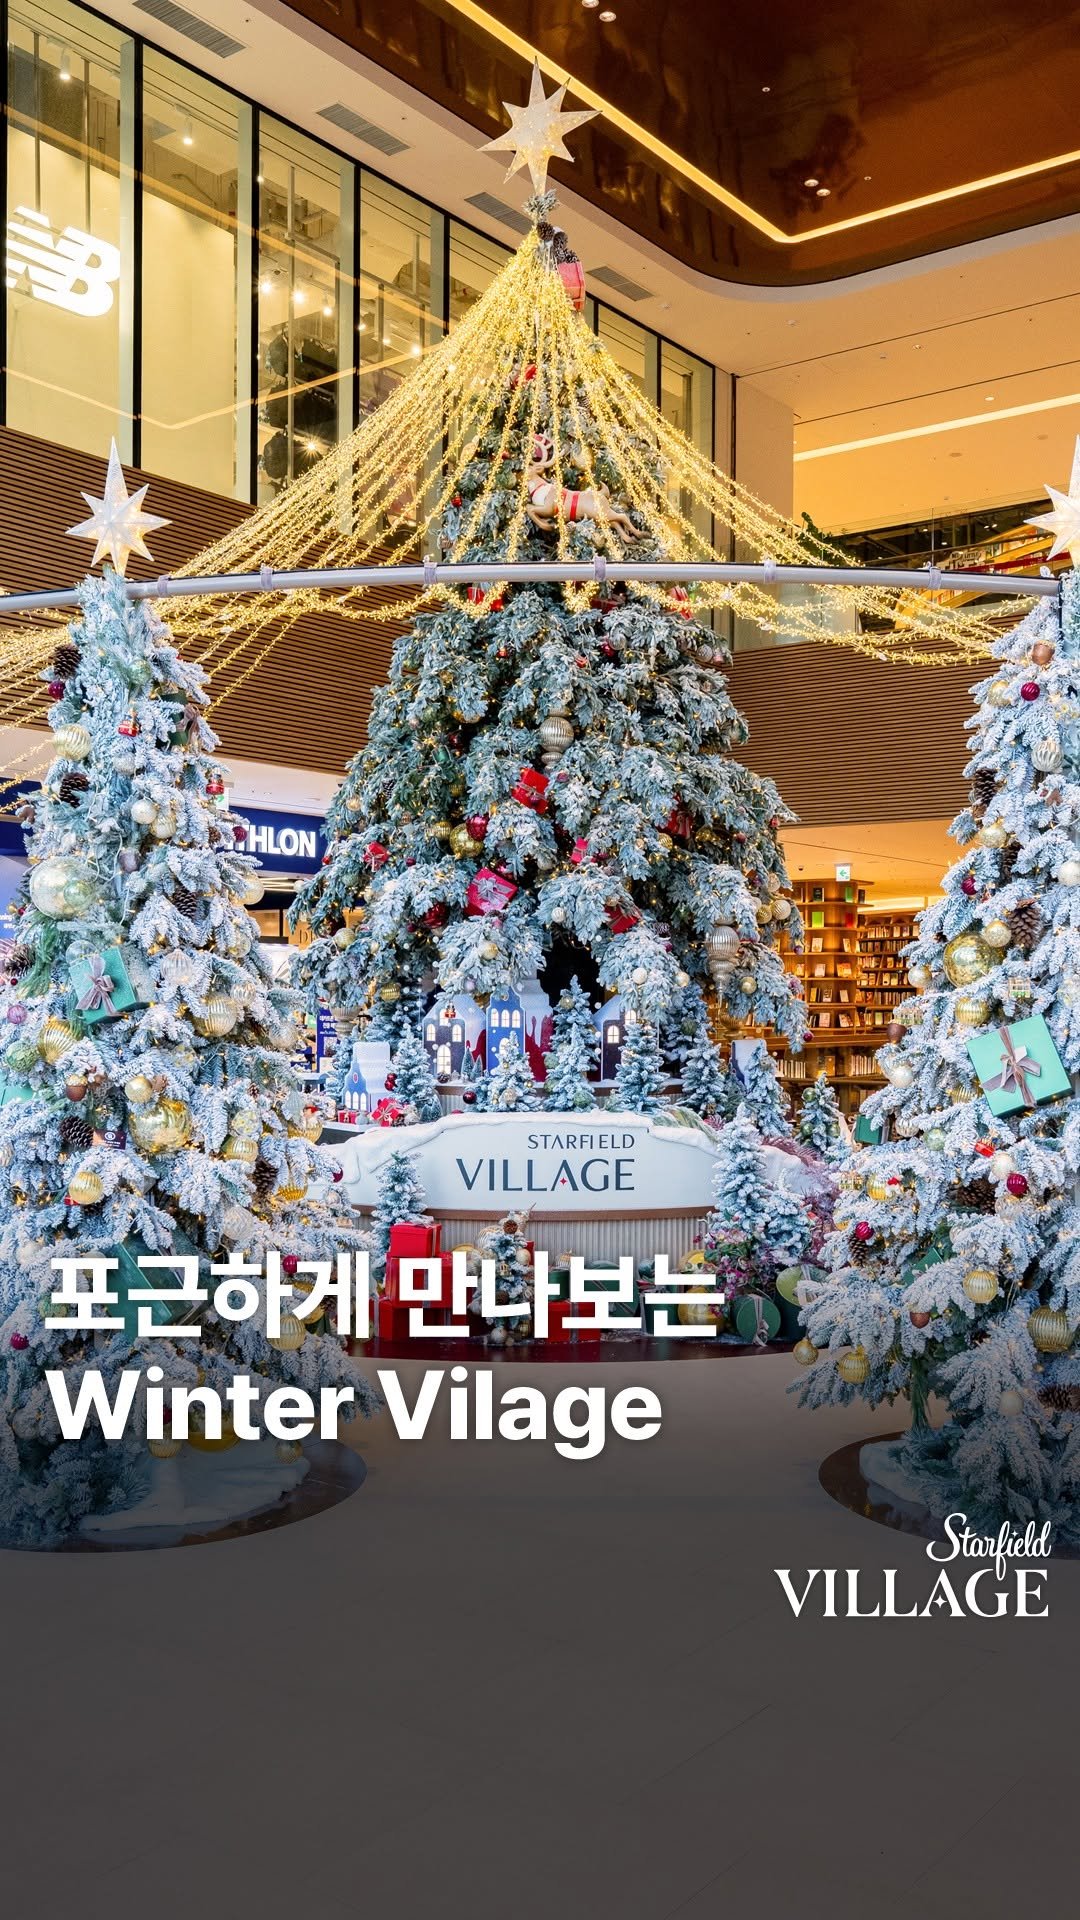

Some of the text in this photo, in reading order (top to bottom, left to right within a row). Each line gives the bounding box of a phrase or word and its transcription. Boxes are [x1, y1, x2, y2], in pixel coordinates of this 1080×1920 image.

[225, 823, 316, 858] THLON
[527, 1133, 635, 1150] STARFIELD
[455, 1158, 635, 1192] VILLAGE
